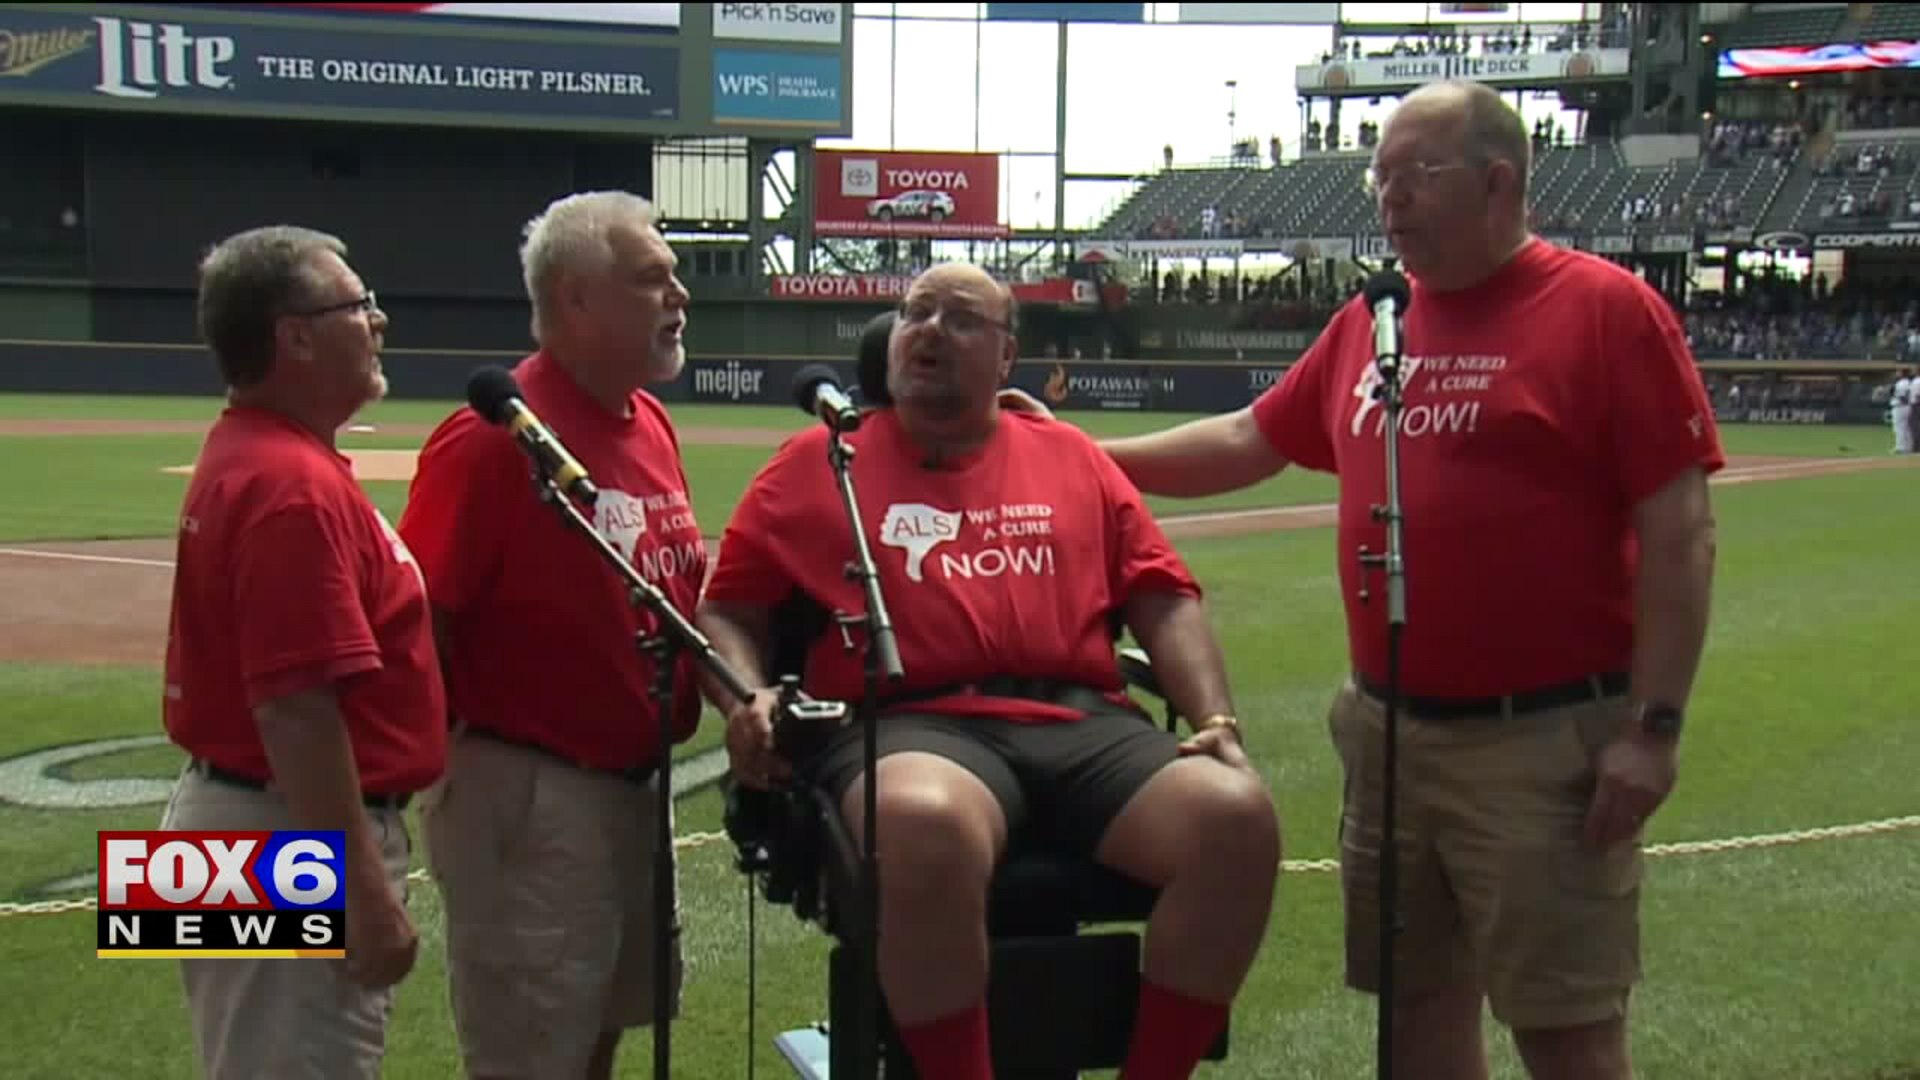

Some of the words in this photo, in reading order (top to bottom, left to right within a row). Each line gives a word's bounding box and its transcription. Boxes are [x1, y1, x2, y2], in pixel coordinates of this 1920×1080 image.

[785, 5, 836, 24] Save
[94, 17, 234, 98] Lite
[258, 56, 314, 79] THE
[321, 59, 449, 85] ORIGINAL
[455, 66, 533, 90] LIGHT
[541, 71, 652, 96] PILSNER.
[1383, 62, 1440, 79] MILLER
[1488, 59, 1530, 73] DECK
[719, 73, 768, 96] WPS
[886, 169, 969, 190] TOYOTA
[780, 275, 859, 296] TOYOTA
[1423, 357, 1450, 371] WE
[1454, 355, 1507, 371] NEED
[695, 361, 764, 400] meijer
[1425, 378, 1437, 393] A
[1441, 375, 1492, 391] CURE
[605, 501, 643, 534] ALS
[966, 508, 998, 525] WE
[1001, 503, 1053, 519] NEED
[893, 514, 953, 538] ALS
[983, 528, 998, 541] A
[1001, 521, 1053, 537] CURE
[940, 545, 1056, 580] NOW!
